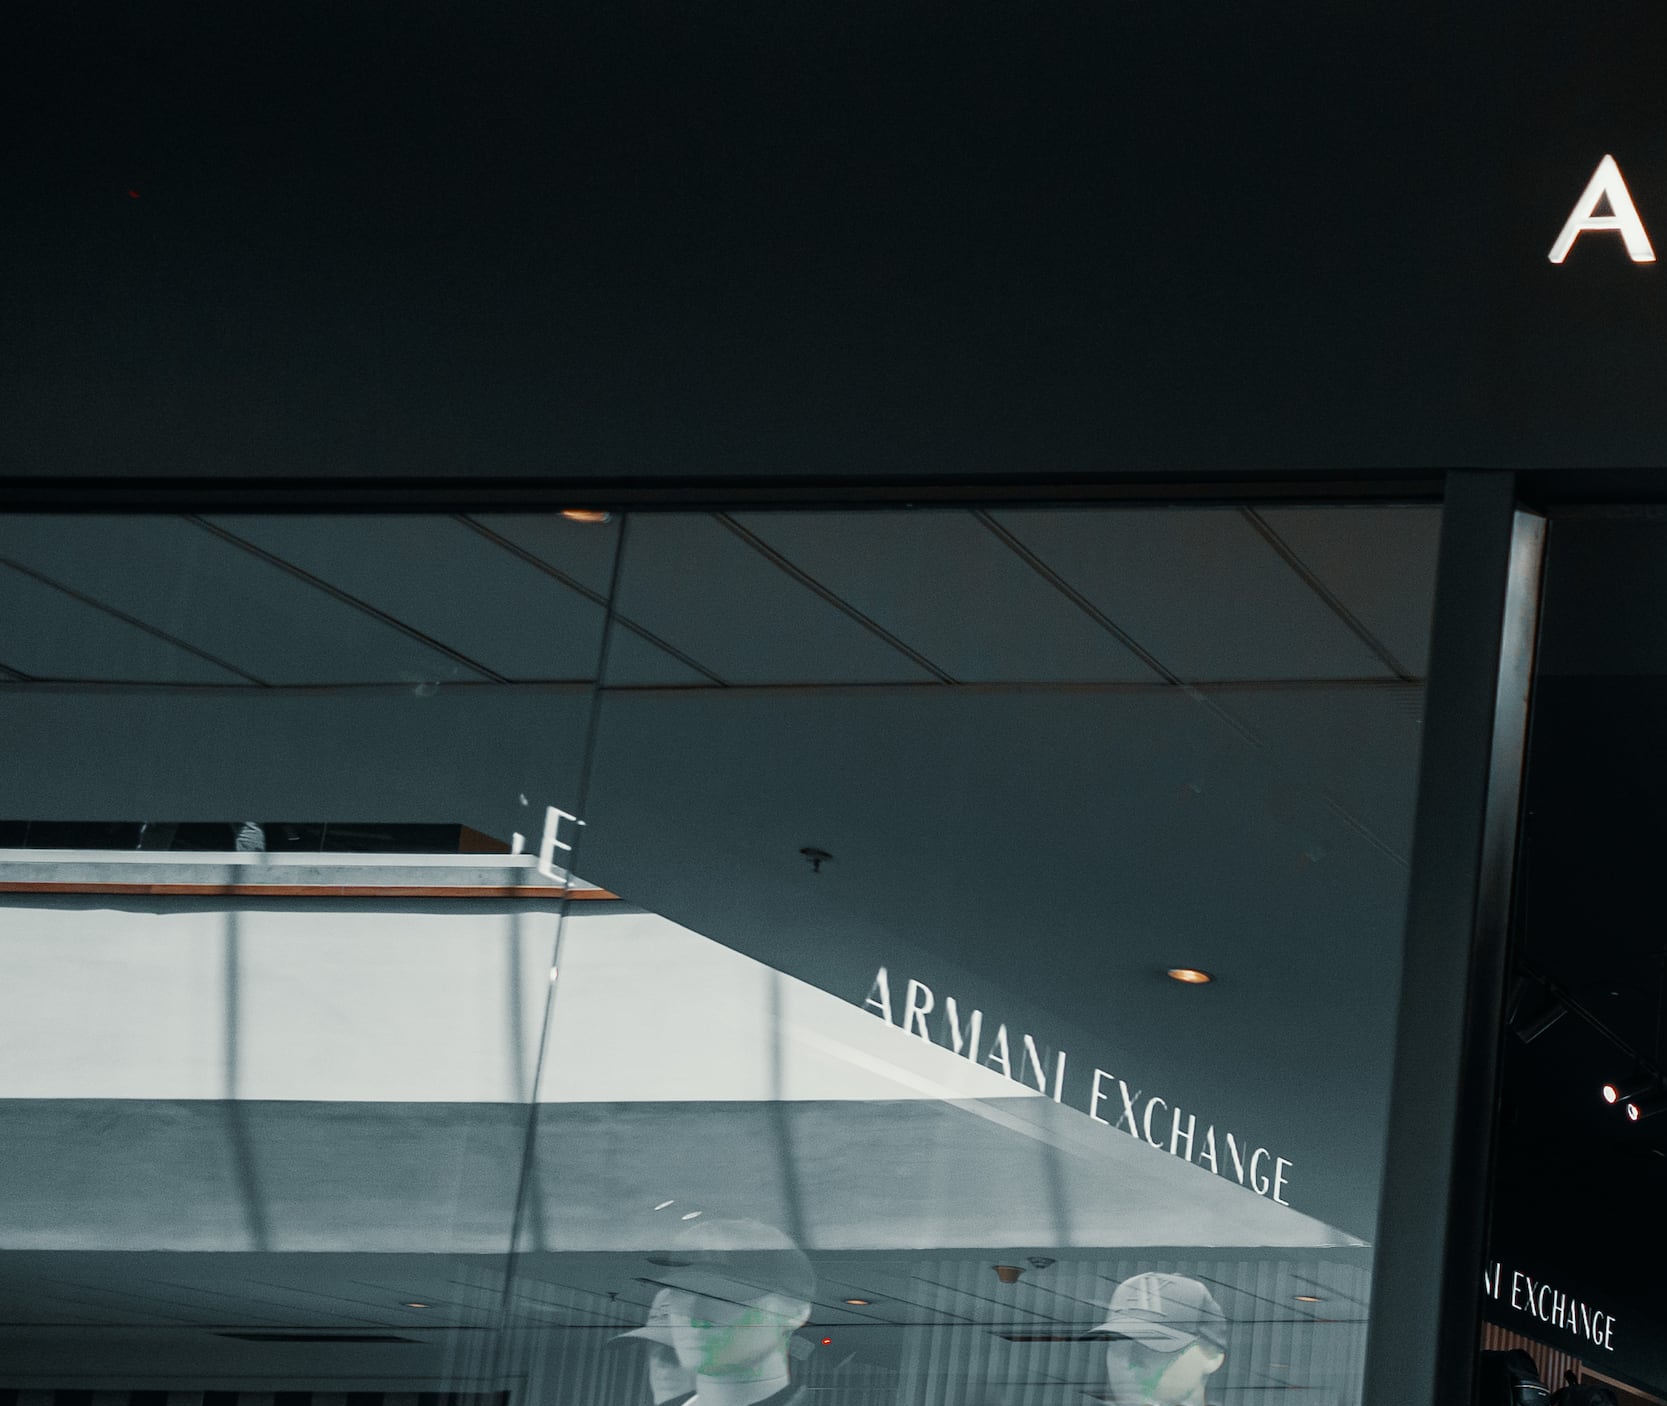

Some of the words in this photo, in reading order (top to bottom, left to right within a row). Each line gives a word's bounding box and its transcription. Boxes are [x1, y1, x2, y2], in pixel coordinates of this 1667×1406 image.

[862, 966, 1066, 1104] ARMANI
[1090, 1067, 1293, 1206] EXCHANGE
[1512, 1272, 1615, 1351] EXCHANGE
